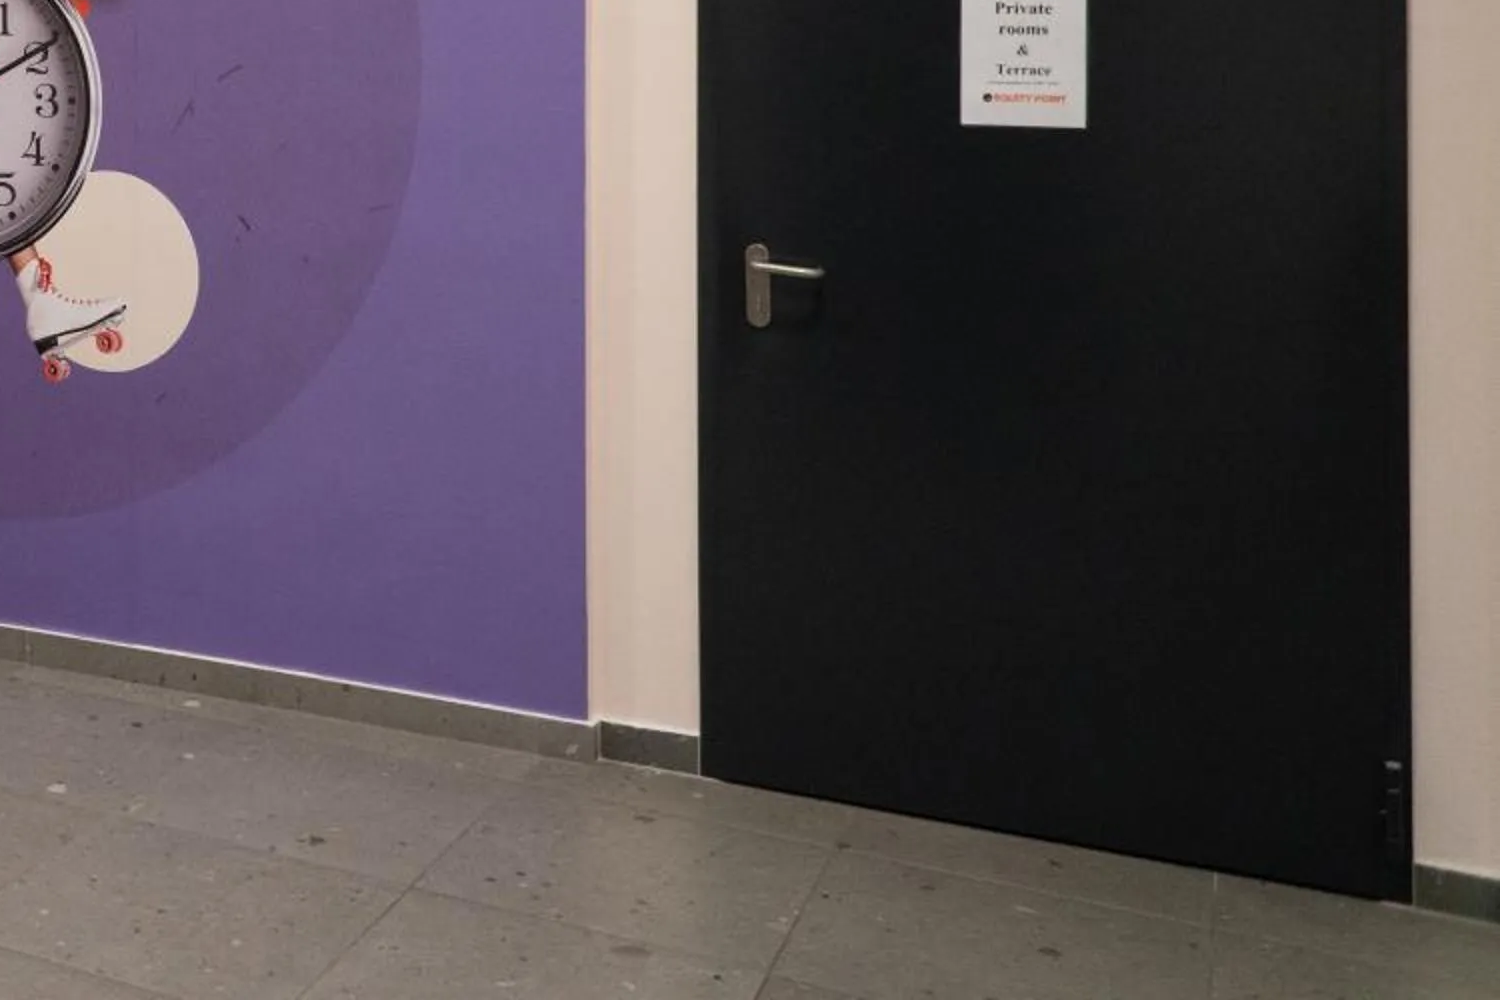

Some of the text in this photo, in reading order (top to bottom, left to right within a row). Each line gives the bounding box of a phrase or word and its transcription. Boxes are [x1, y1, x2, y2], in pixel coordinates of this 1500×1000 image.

[995, 1, 1053, 15] Private
[998, 24, 1049, 36] rooms
[1016, 44, 1029, 56] &
[23, 41, 49, 75] 2
[997, 63, 1052, 77] Terrace
[35, 83, 59, 118] 3
[21, 131, 45, 167] 4
